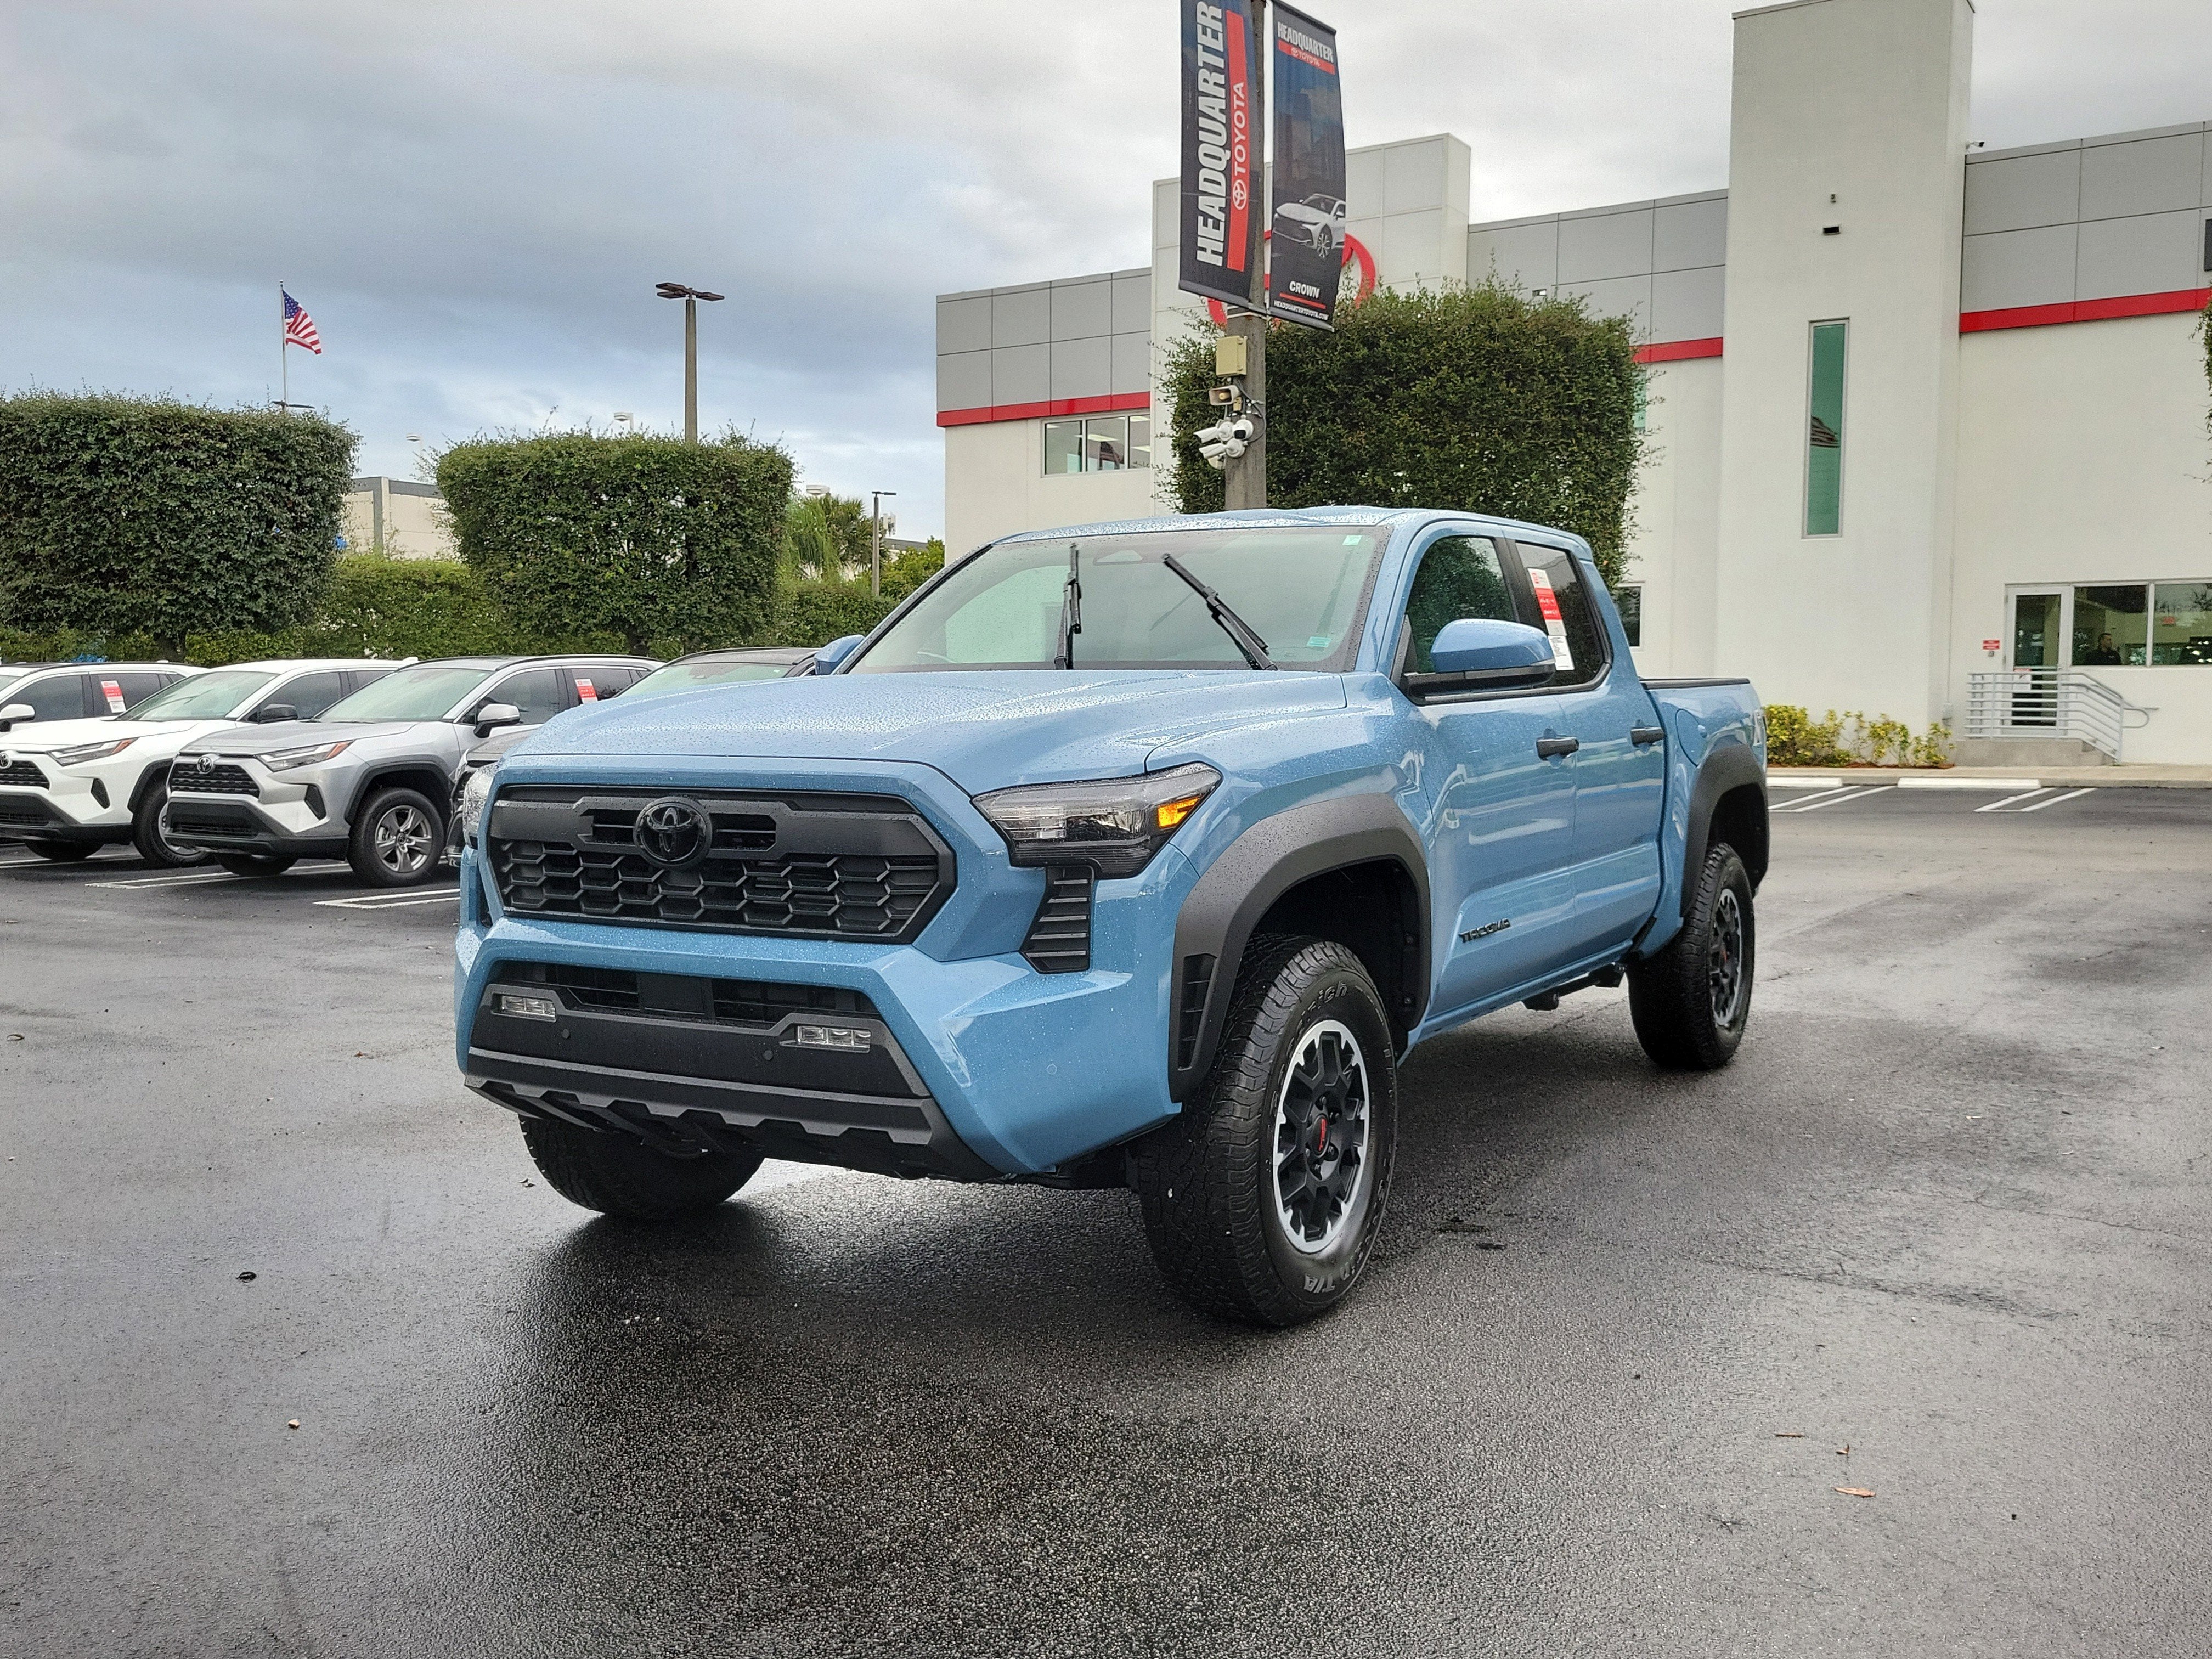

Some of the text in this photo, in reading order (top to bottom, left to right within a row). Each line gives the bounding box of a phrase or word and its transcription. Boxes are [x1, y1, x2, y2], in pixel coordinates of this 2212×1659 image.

[1277, 21, 1334, 63] HEADQUARTER
[1298, 52, 1321, 67] TOYOTA
[1197, 1, 1231, 267] HEADQUARTER
[1233, 82, 1246, 176] TOYOTA
[1289, 280, 1320, 299] CROWN
[1458, 918, 1511, 943] TACOMA
